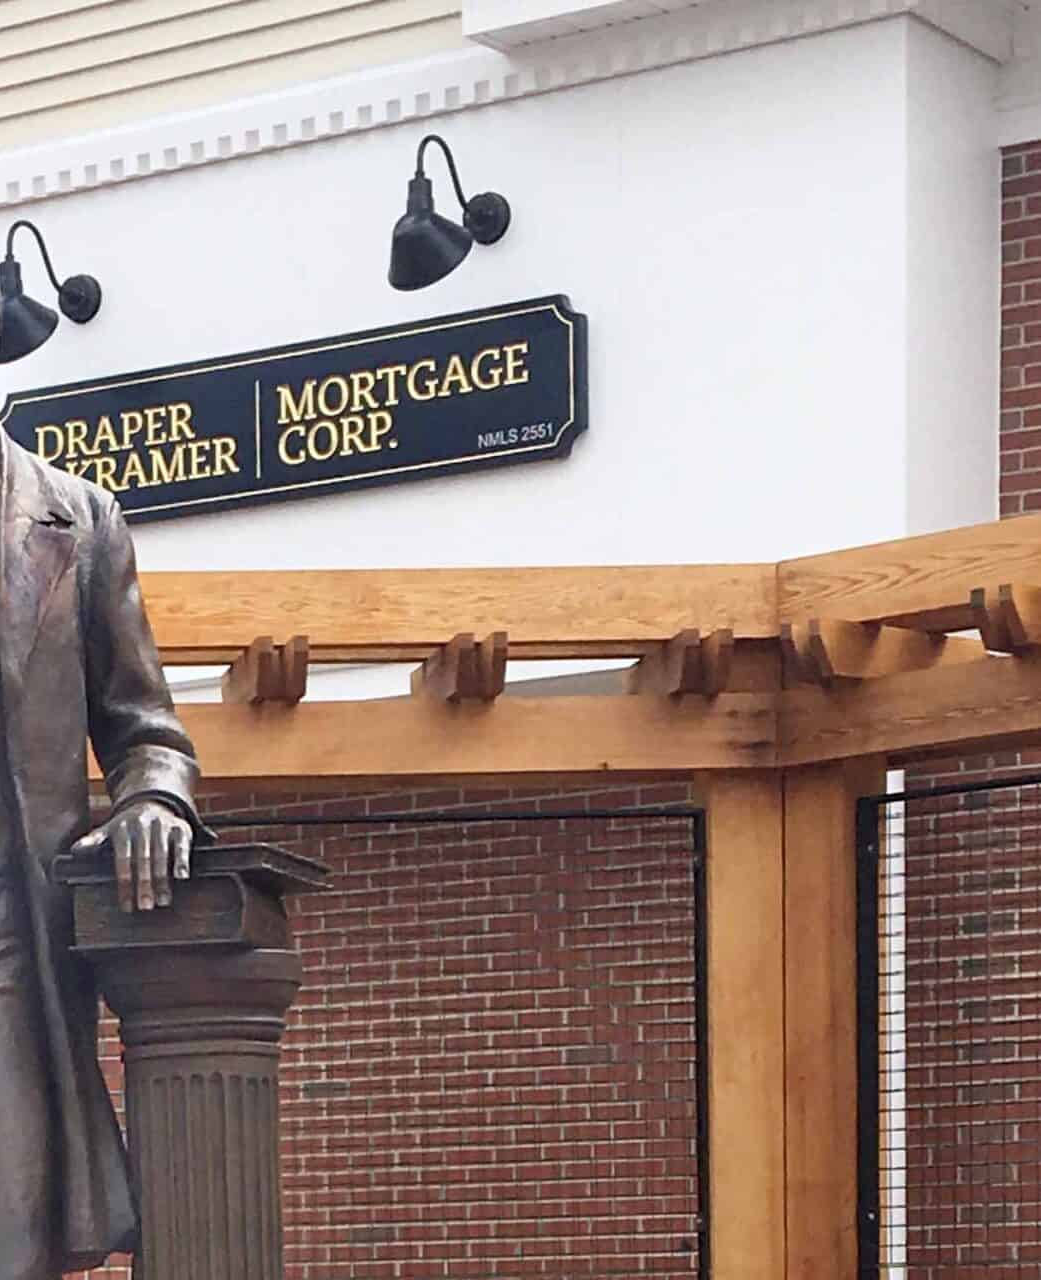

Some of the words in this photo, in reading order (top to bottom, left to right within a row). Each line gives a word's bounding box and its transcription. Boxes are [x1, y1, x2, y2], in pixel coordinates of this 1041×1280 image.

[276, 342, 530, 425] MORTGAGE
[34, 402, 196, 464] DRAPER
[278, 411, 399, 466] CORP.
[477, 427, 519, 449] NMLS
[521, 421, 554, 442] 2551
